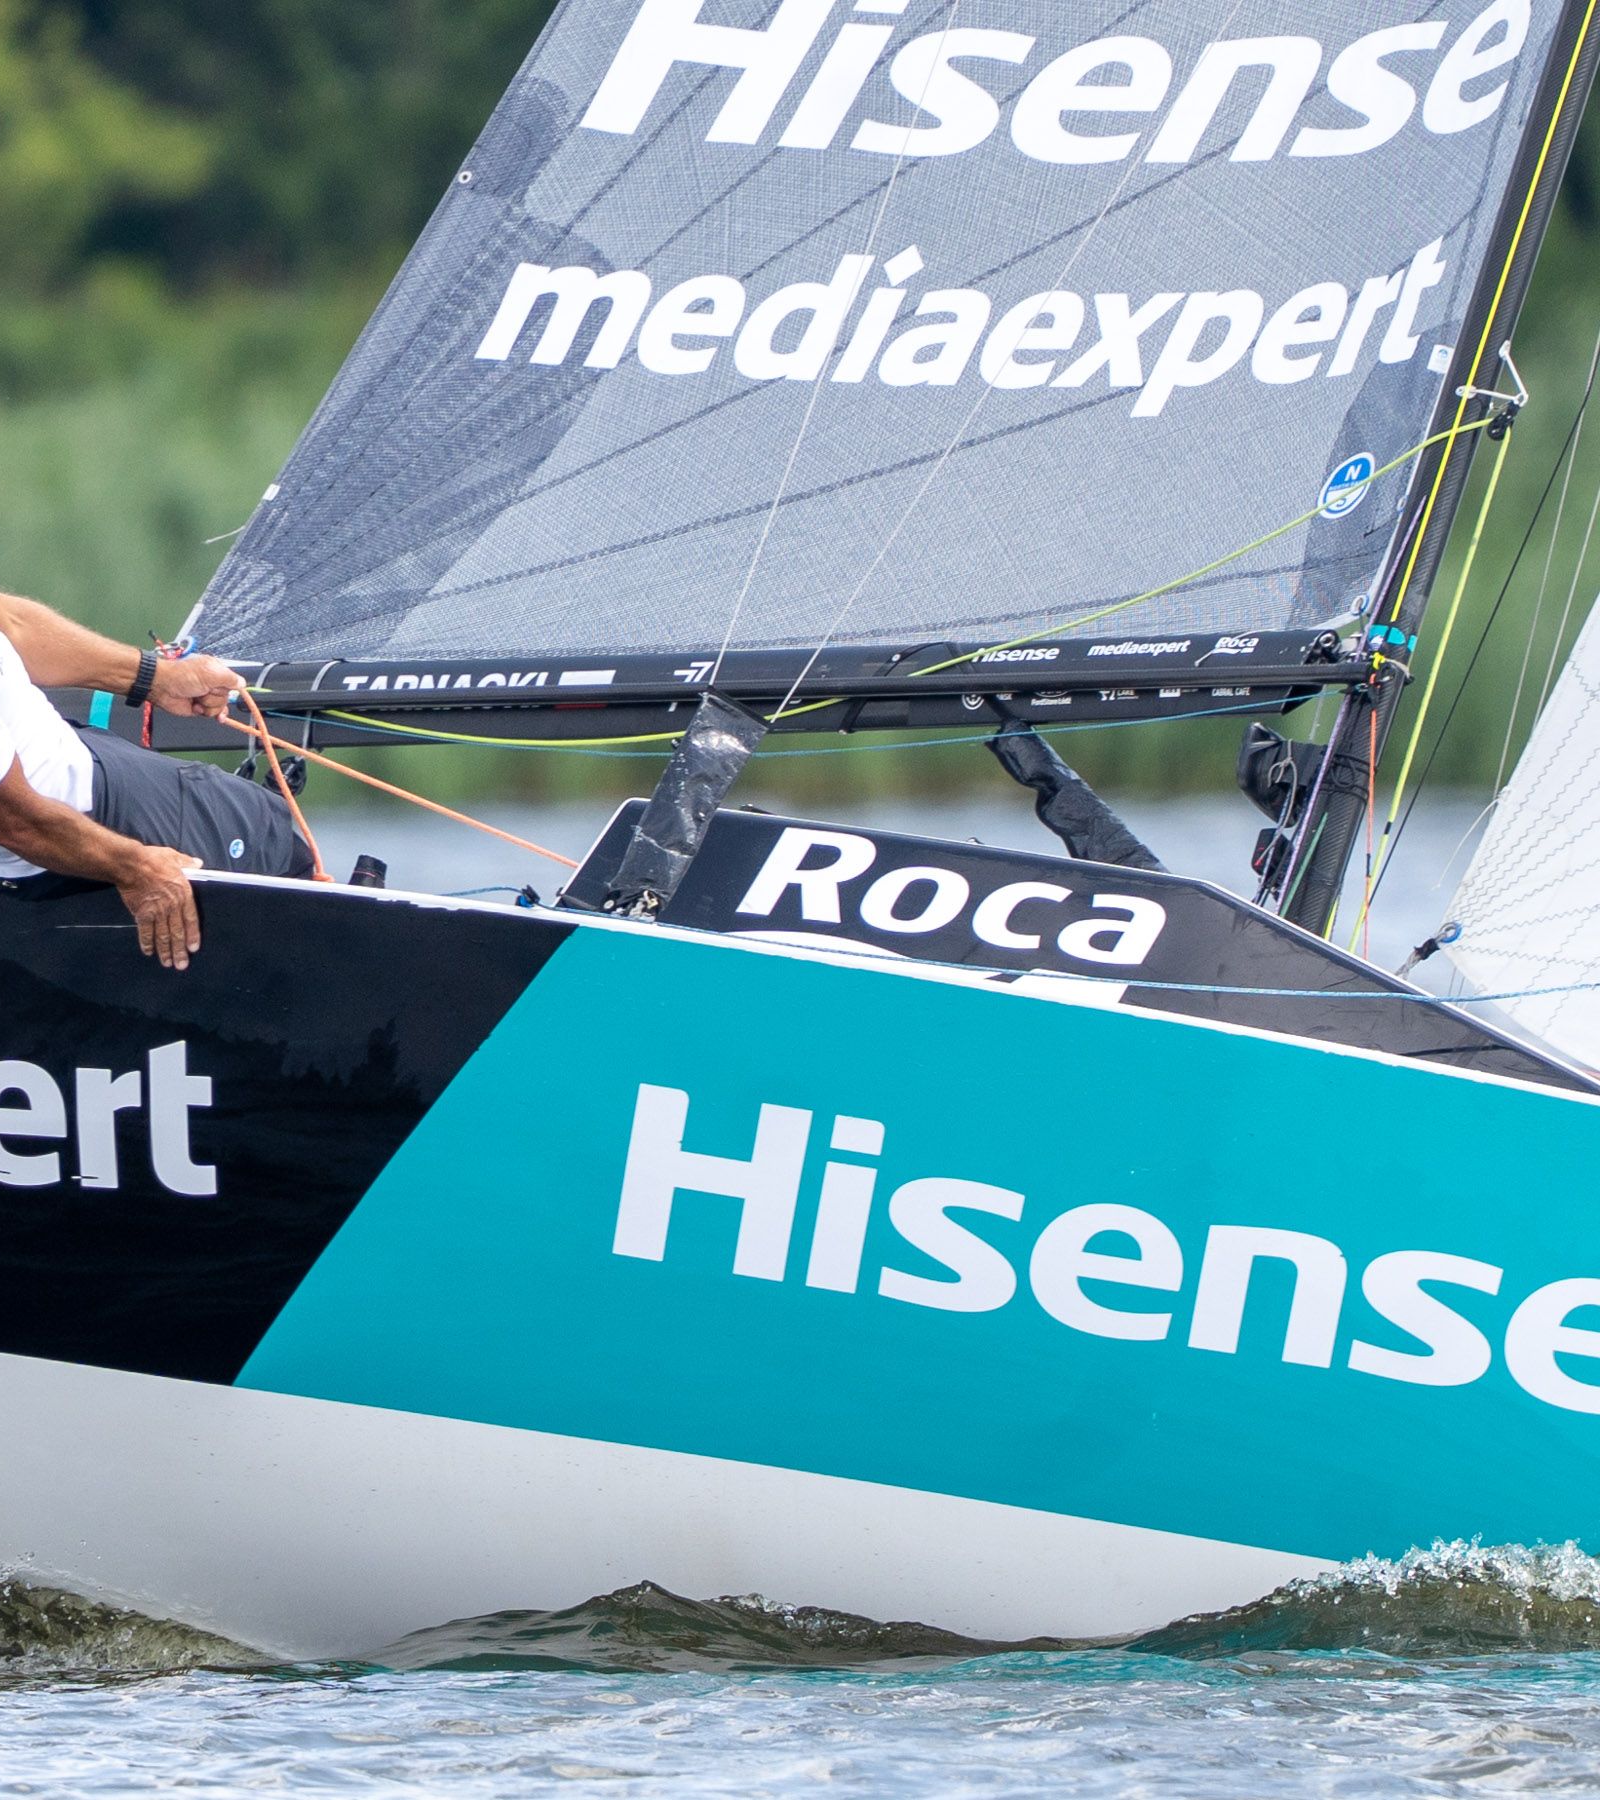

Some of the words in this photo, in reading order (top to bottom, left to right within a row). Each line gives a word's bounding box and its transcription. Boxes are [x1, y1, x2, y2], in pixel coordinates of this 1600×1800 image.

[580, 0, 1532, 164] Hisense
[474, 236, 1448, 418] mediaexpert
[1087, 639, 1191, 657] mediaexpert
[735, 826, 1167, 965] Roca
[612, 1083, 1600, 1415] Hisense
